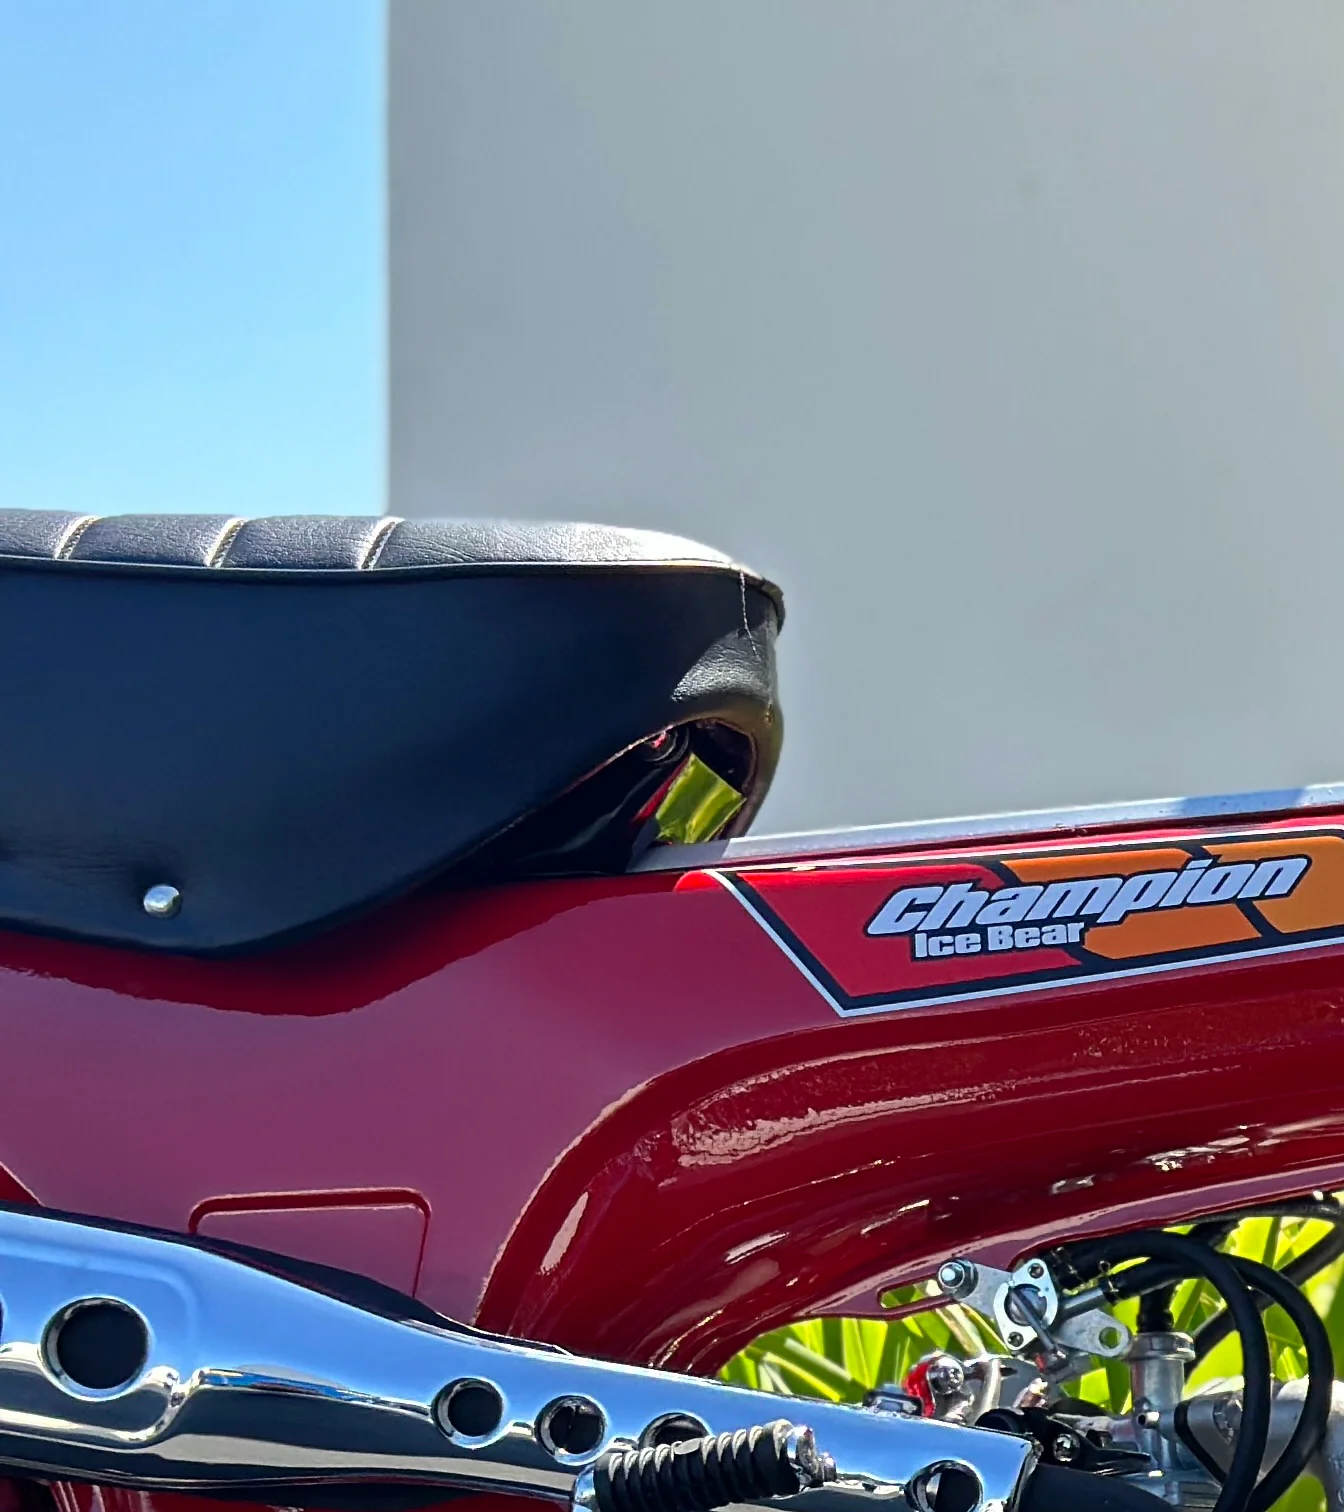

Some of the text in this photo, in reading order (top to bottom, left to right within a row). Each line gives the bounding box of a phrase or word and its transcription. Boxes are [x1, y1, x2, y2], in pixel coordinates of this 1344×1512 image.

[868, 856, 1310, 936] Champion
[914, 918, 1085, 959] Ice Bear
